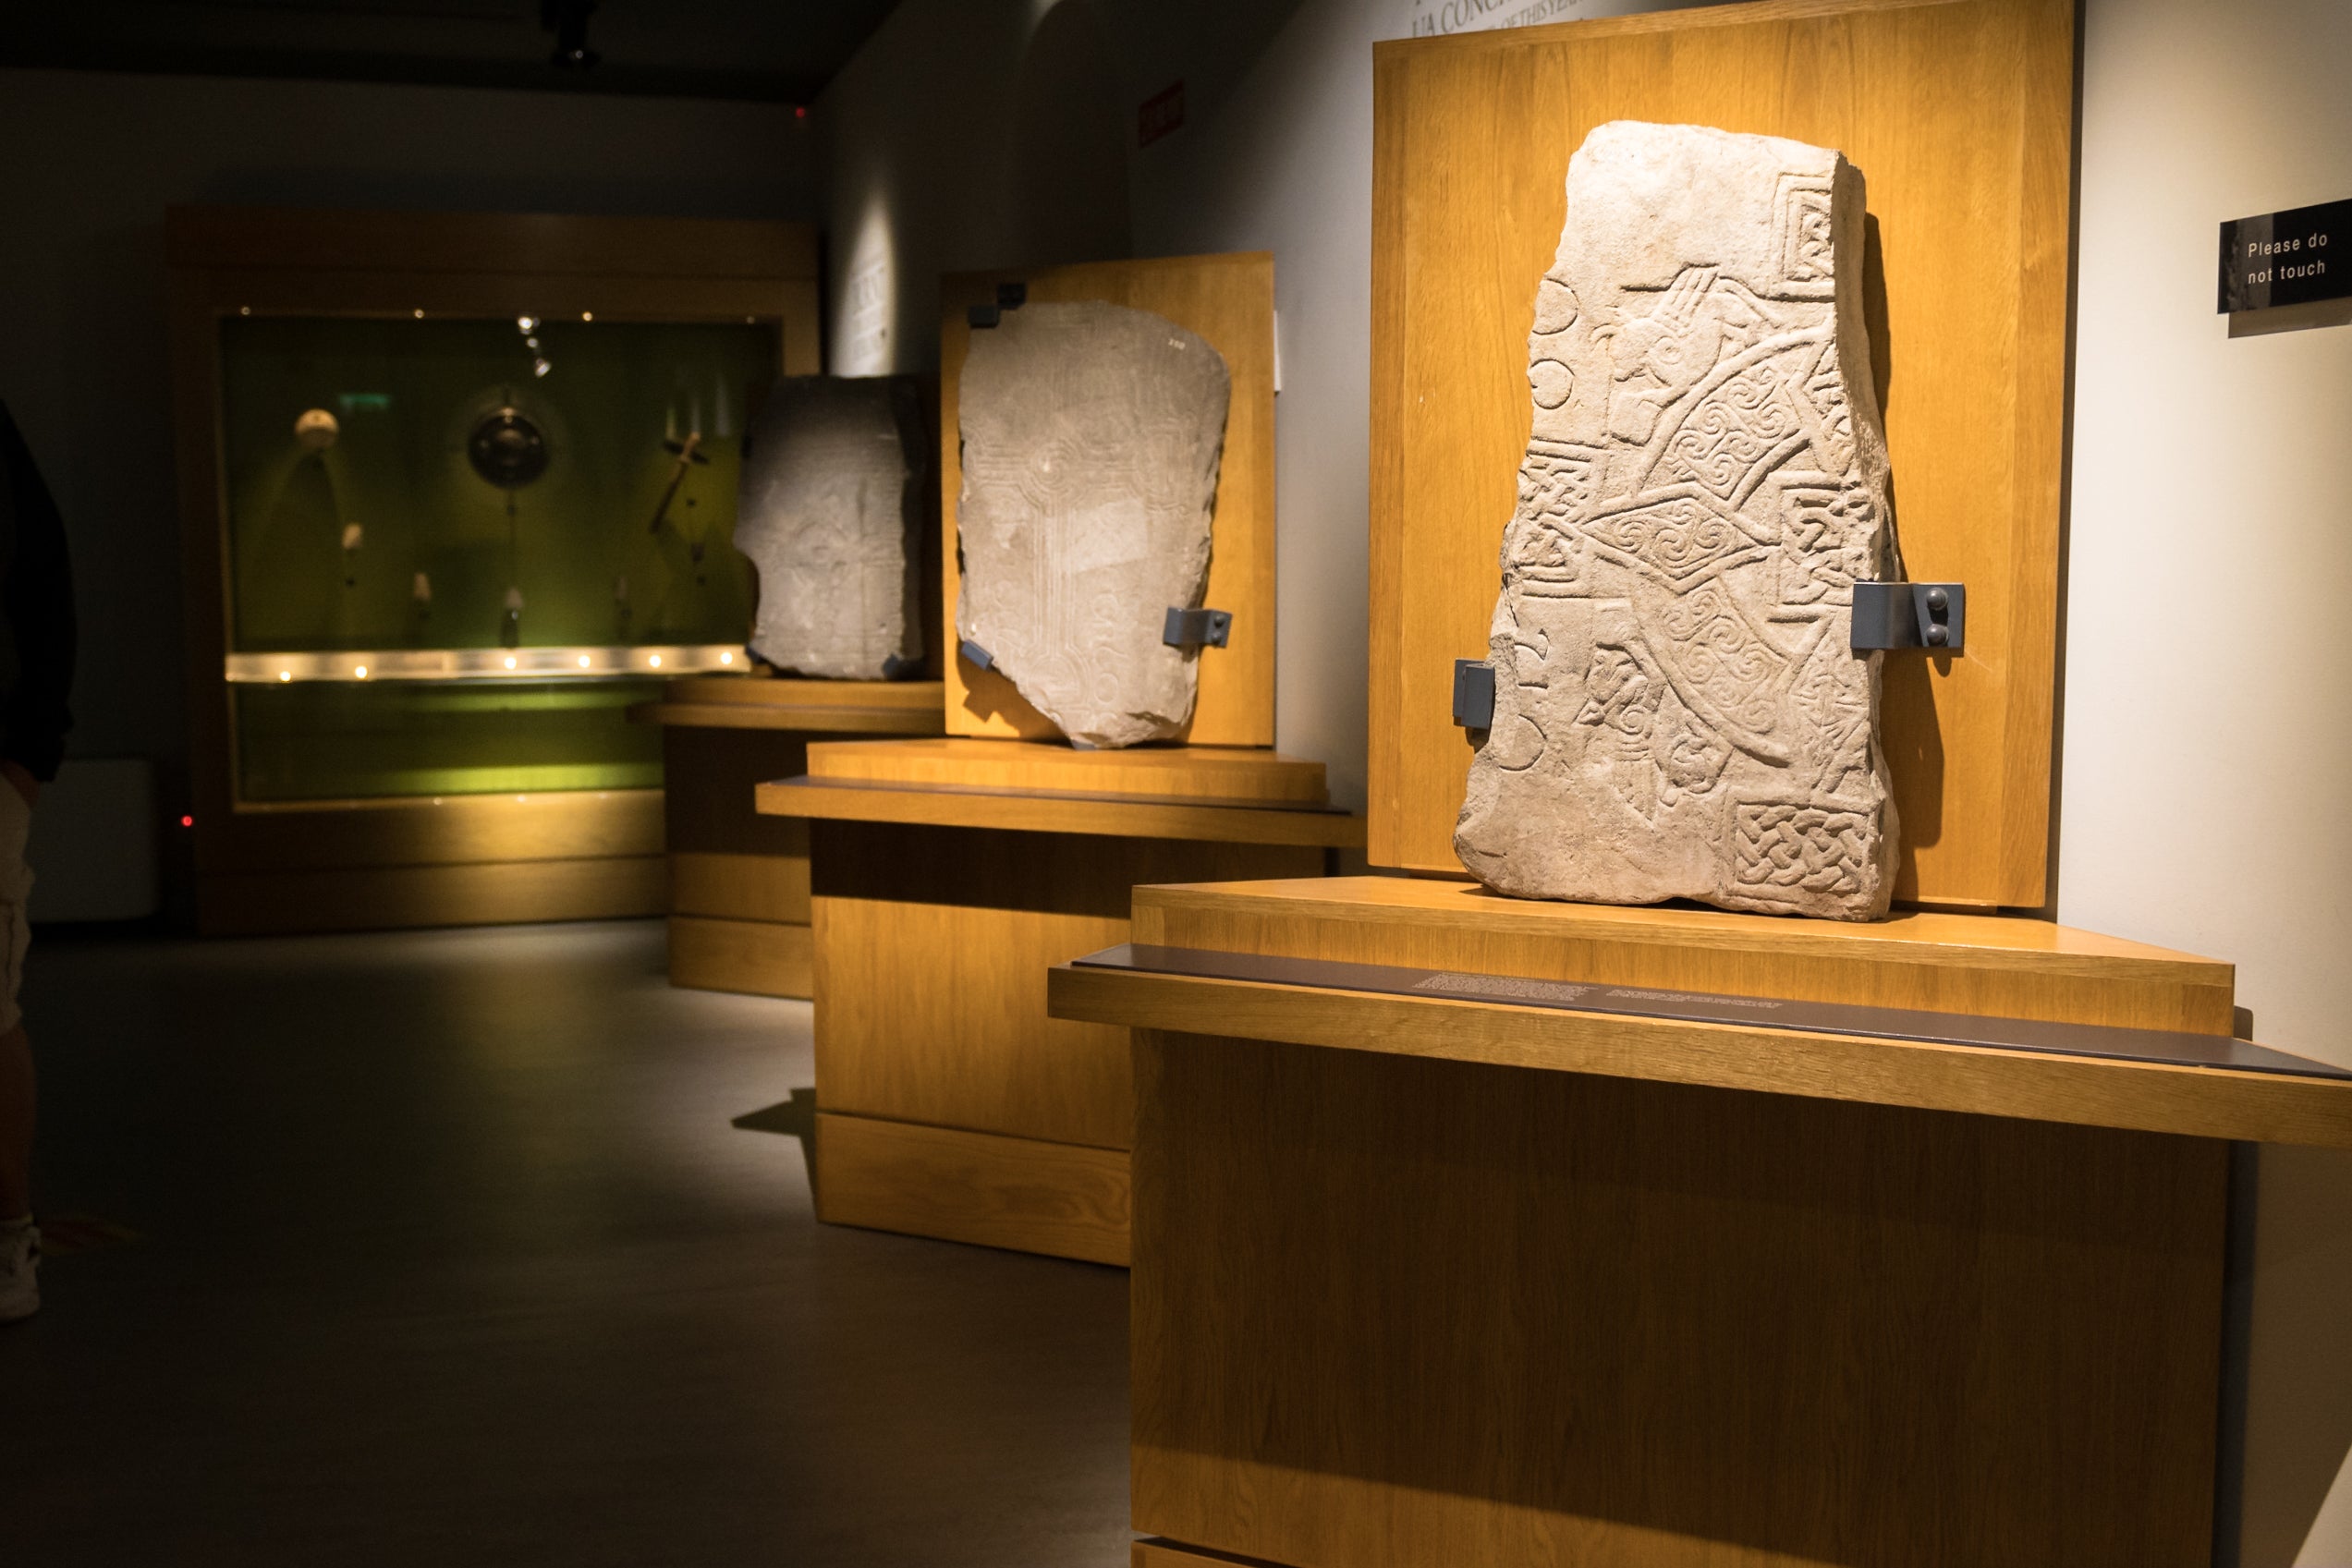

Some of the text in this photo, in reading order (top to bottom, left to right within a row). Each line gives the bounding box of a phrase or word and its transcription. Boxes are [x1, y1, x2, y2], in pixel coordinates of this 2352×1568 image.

[1441, 0, 1511, 33] CON
[1547, 0, 1583, 15] YE
[2248, 233, 2328, 258] Please do
[2248, 261, 2325, 285] not touch
